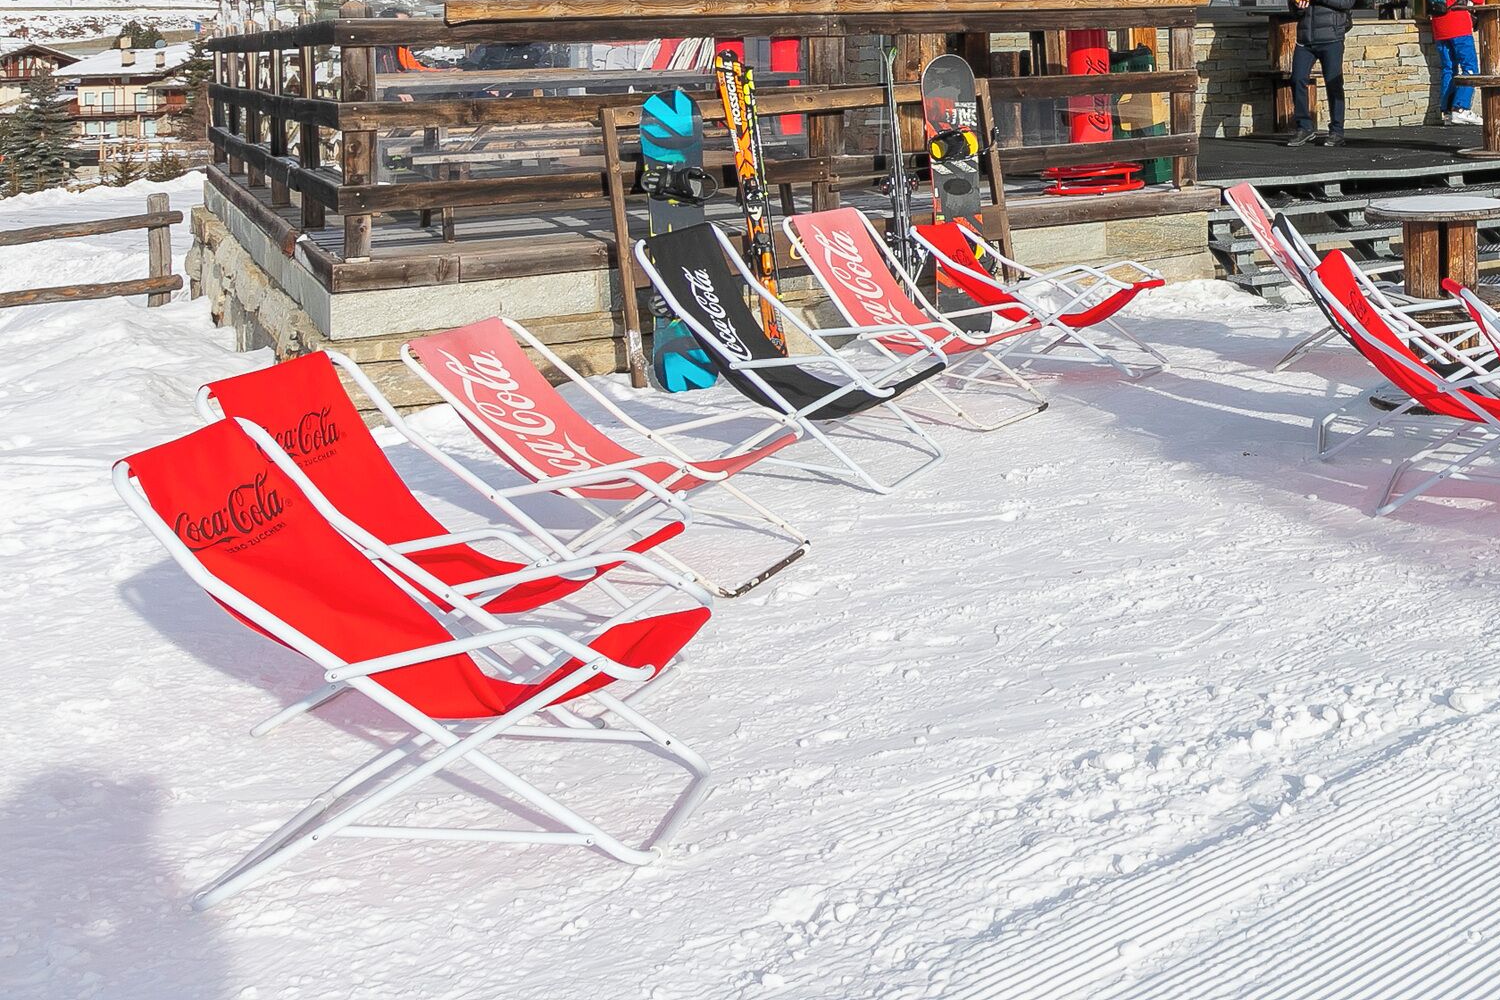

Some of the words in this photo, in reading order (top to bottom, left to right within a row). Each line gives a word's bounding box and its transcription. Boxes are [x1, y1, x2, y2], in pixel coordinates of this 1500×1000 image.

[303, 449, 338, 466] ZUCCHERI
[174, 469, 285, 553] Coca-Cola
[249, 521, 287, 547] ZUCCHERI
